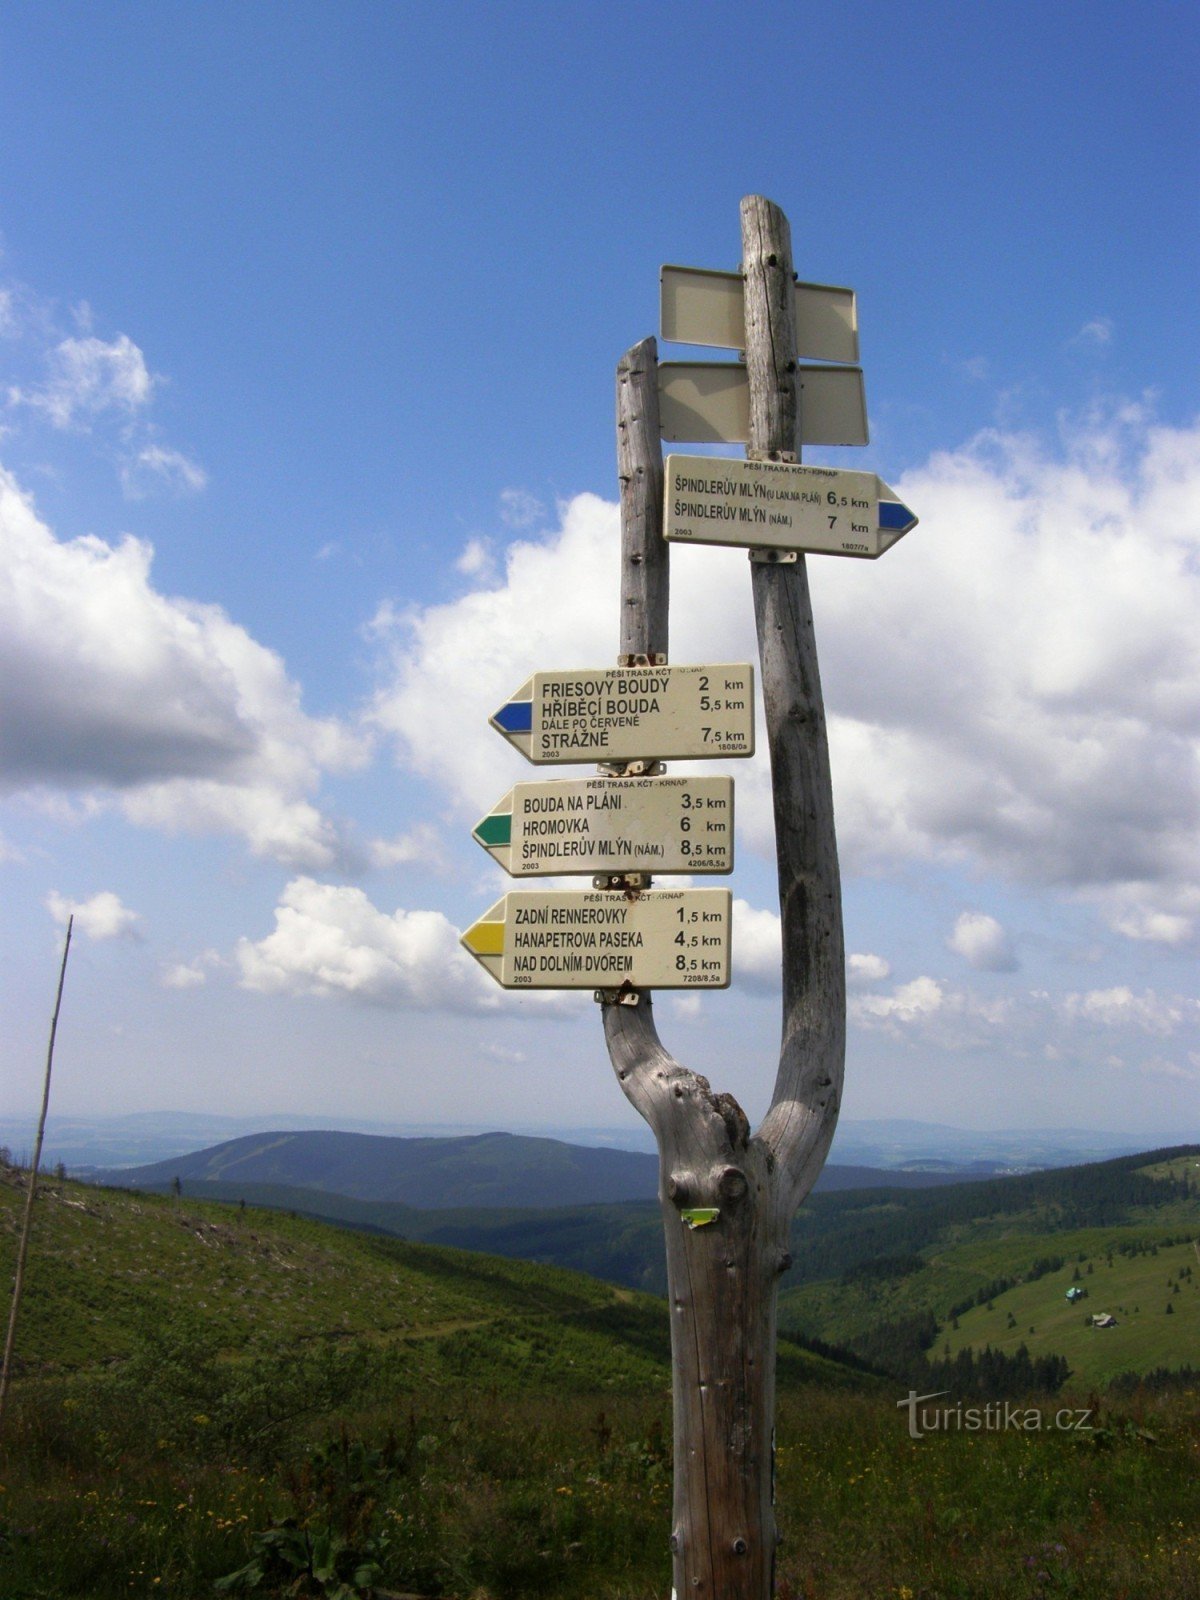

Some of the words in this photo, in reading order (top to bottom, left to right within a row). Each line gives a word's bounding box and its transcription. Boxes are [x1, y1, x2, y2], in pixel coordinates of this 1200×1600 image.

[764, 465, 789, 473] TRASA
[675, 475, 737, 496] ŠPINDLERŮV
[739, 480, 766, 499] MLÝN
[827, 491, 847, 507] 6,5
[851, 497, 869, 509] km
[674, 499, 736, 520] ŠPINDLERŮV
[739, 505, 766, 523] MLÝN
[769, 513, 792, 527] (NÁM.)
[827, 515, 837, 529] 7
[851, 523, 869, 533] km
[674, 528, 692, 536] 2003
[606, 670, 624, 678] PĚŠÍ
[627, 669, 654, 677] TRASA
[542, 680, 614, 697] FRIESOVY
[618, 678, 669, 694] BOUDY
[699, 677, 709, 691] 2
[724, 679, 744, 690] km
[542, 697, 602, 717] HŘÍBĚCÍ
[607, 698, 660, 715] BOUDA
[700, 696, 721, 712] 5,5
[725, 700, 745, 710] km
[542, 717, 569, 730] DÁLE
[573, 718, 587, 729] PO
[590, 714, 639, 728] ČERVENÉ
[542, 728, 608, 749] STRÁŽNÉ
[701, 728, 721, 743] 7,5
[726, 731, 744, 741] km
[587, 780, 605, 789] PĚŠÍ
[637, 780, 653, 788] KČT
[524, 797, 565, 814] BOUDA
[567, 796, 583, 810] NA
[586, 791, 622, 811] PLÁNI
[681, 793, 703, 810] 3,5
[706, 798, 726, 809] km
[523, 819, 590, 836] HROMOVKA
[680, 818, 691, 832] 6
[706, 821, 726, 832] km
[522, 836, 595, 859] ŠPINDLERŮV
[598, 836, 632, 856] MLÝN
[634, 842, 664, 857] (NÁM.)
[680, 840, 703, 858] 8,5
[706, 844, 726, 855] km
[688, 860, 725, 868] 4206/8,5a
[584, 893, 602, 902] PĚŠÍ
[515, 906, 549, 924] ZADNÍ
[551, 908, 628, 924] RENNEROVKY
[676, 907, 698, 924] 1,5
[702, 912, 722, 923] km
[514, 932, 597, 948] HANAPETROVA
[599, 931, 643, 947] PASEKA
[674, 931, 699, 948] 4,5
[701, 936, 721, 946] km
[514, 956, 536, 971] NAD
[540, 952, 582, 971] DOLNÍM
[585, 956, 633, 971] DVOREM
[675, 955, 698, 972] 8,5
[701, 959, 721, 970] km
